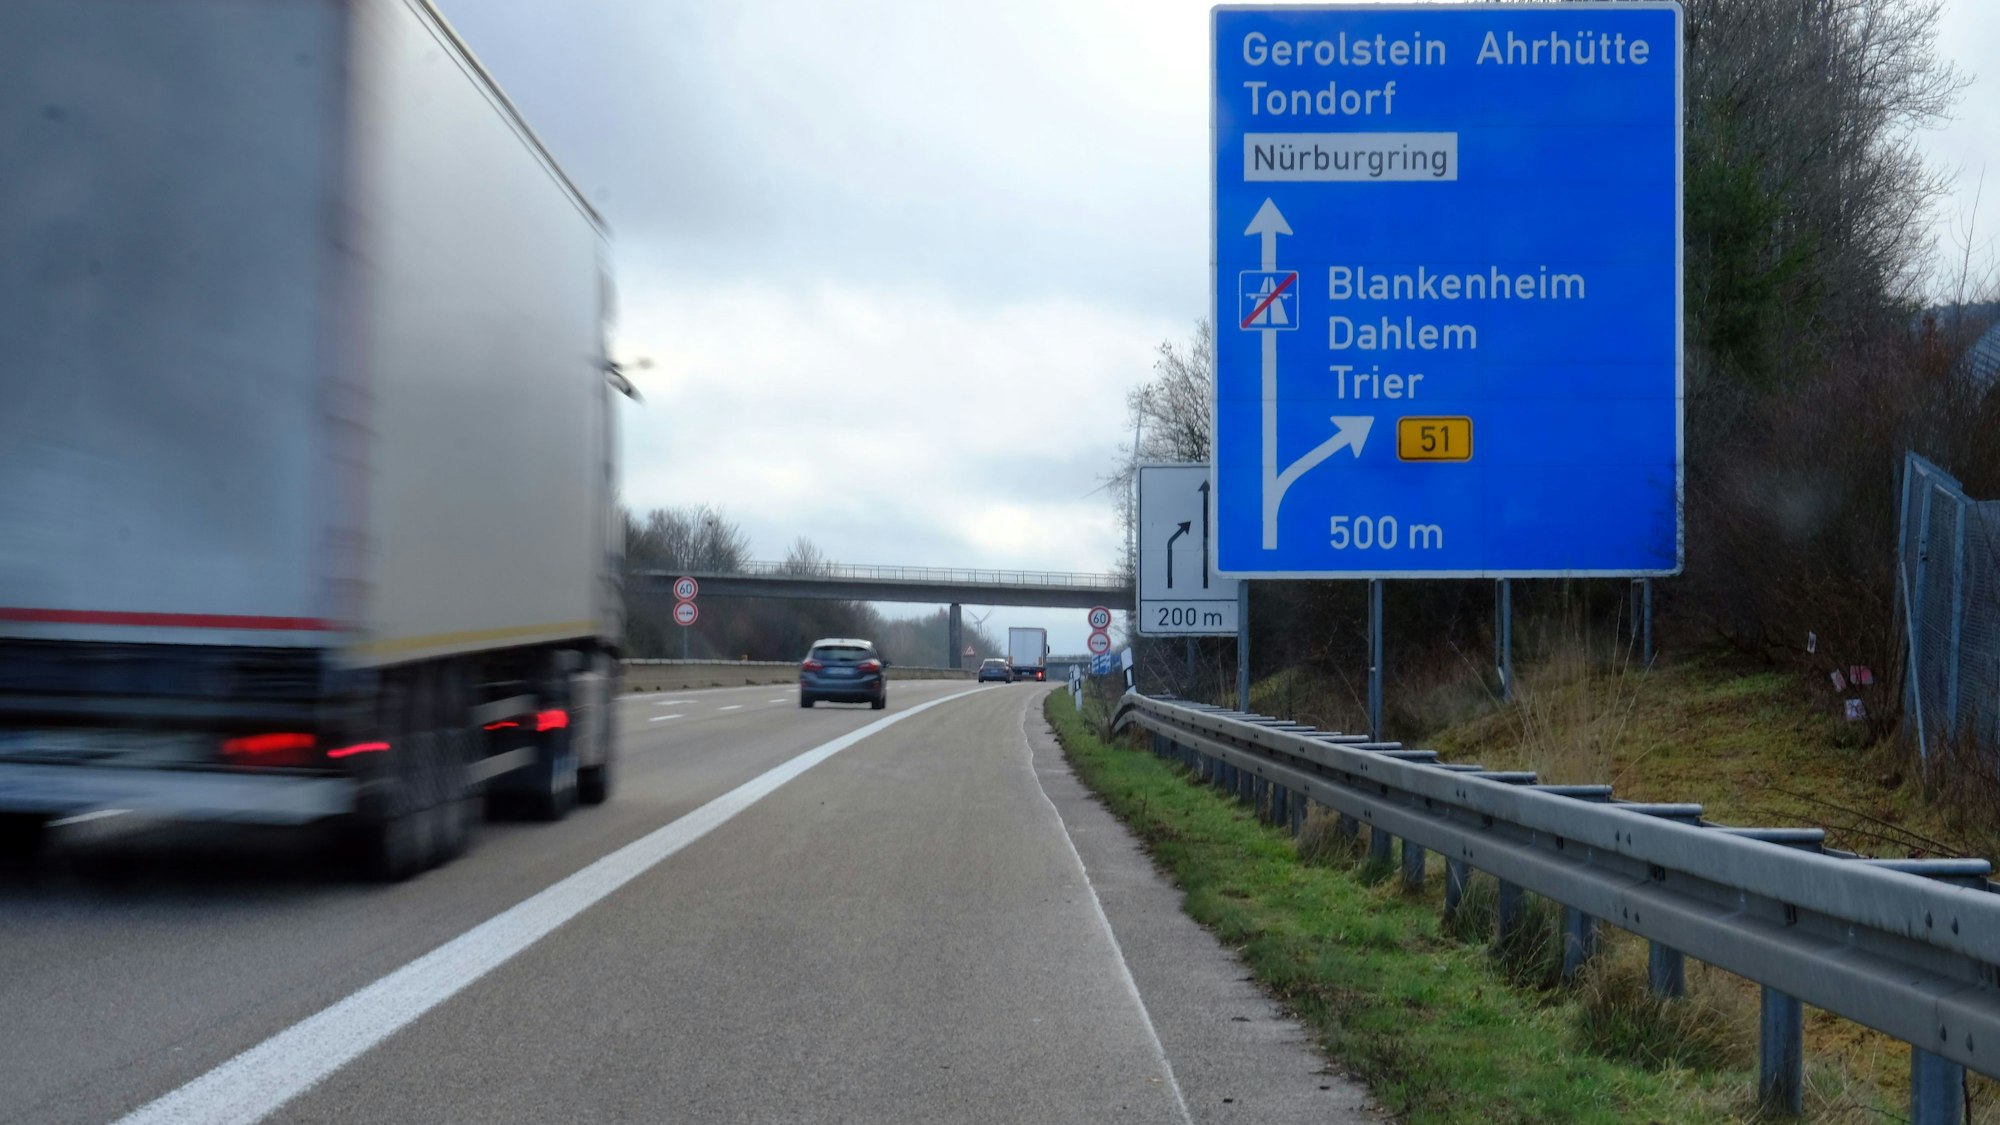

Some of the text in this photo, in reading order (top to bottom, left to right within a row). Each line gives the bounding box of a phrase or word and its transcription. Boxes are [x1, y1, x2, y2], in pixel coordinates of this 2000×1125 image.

[1243, 31, 1650, 66] Gerolstein Ahrhütte
[1243, 80, 1396, 115] Tondorf
[1253, 144, 1448, 177] Nürburgring
[1328, 265, 1585, 300] Blankenheim
[1328, 316, 1477, 350] Dahlem
[1329, 365, 1424, 399] Trier
[1420, 426, 1450, 452] 51
[1329, 516, 1443, 550] 500 m
[679, 583, 693, 595] 60
[1093, 613, 1107, 624] 60
[1158, 607, 1223, 626] 200 m
